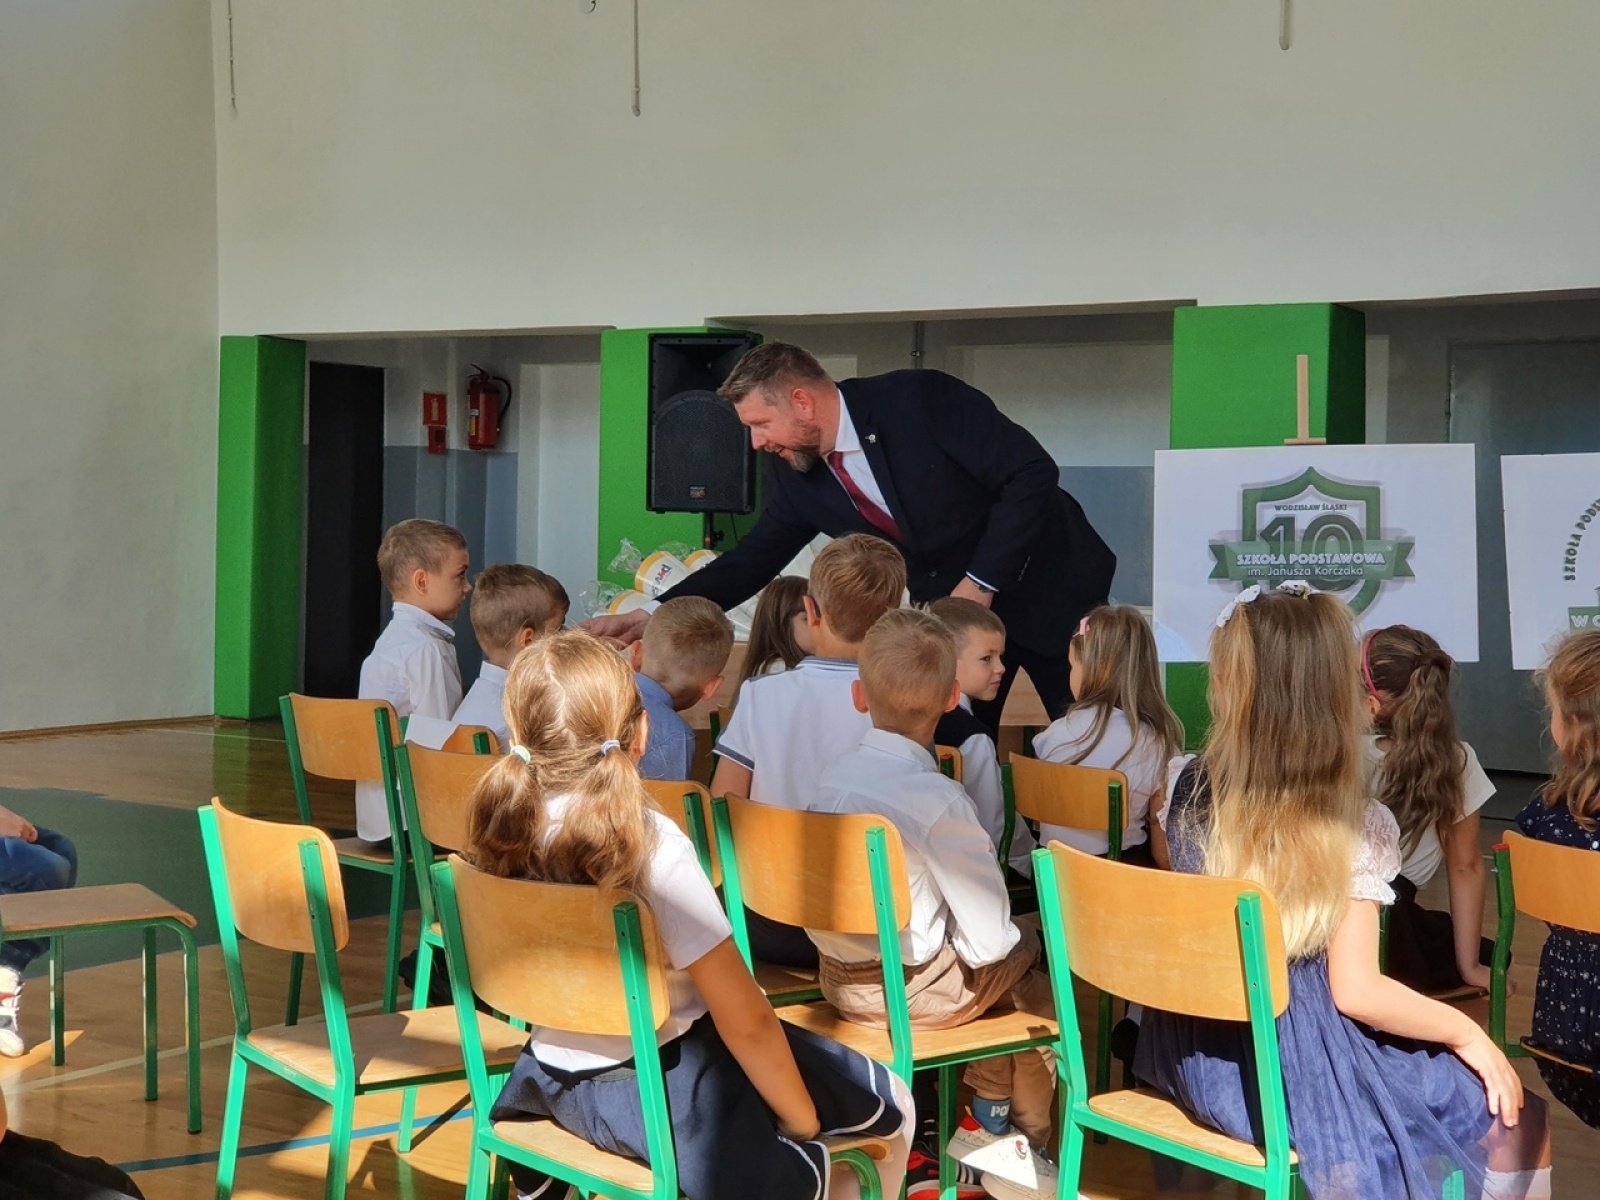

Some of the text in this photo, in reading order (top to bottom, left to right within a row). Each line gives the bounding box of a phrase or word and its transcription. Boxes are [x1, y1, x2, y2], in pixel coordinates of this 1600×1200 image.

[1321, 502, 1347, 512] ŚLĄSKI
[1259, 514, 1365, 591] 10
[1563, 533, 1583, 581] SZKOŁA
[1236, 553, 1385, 566] SZKOŁA PODSTAWOWA
[1247, 566, 1364, 576] im. Janusza Korczaka
